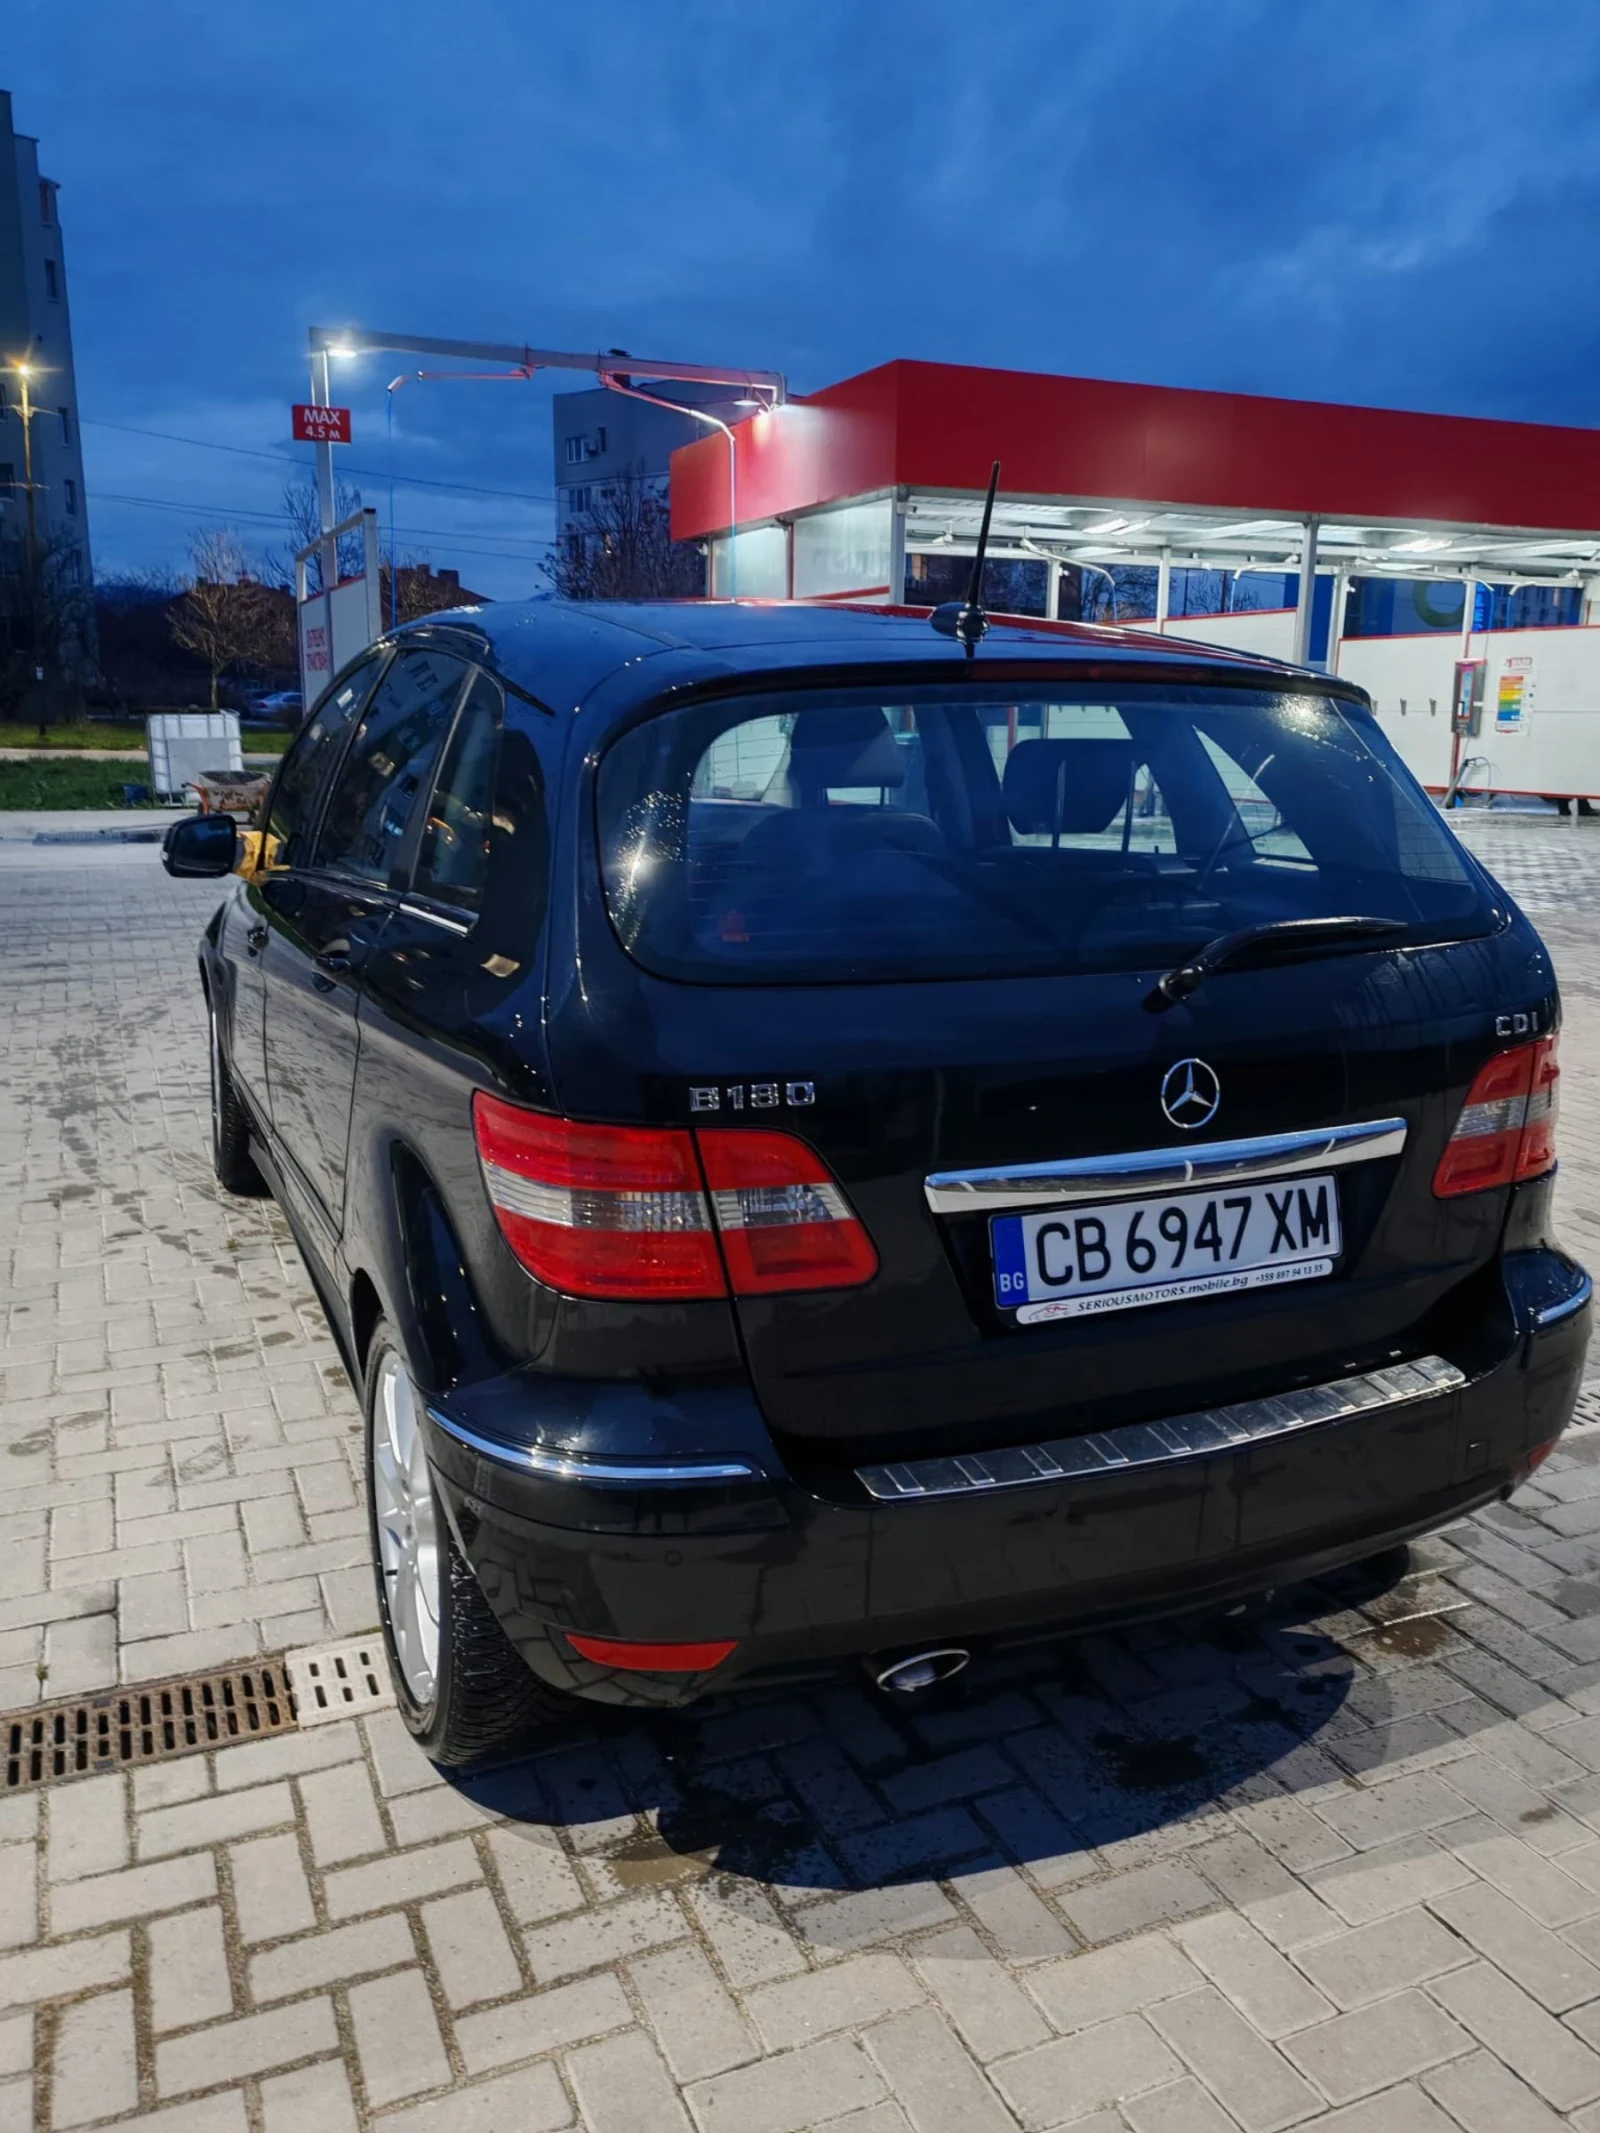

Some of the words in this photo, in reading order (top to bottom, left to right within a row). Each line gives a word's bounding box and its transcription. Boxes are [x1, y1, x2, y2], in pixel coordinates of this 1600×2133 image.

[304, 408, 341, 425] MAX
[305, 425, 325, 439] 4.5
[1495, 1011, 1538, 1036] CDI
[689, 1082, 816, 1112] B180
[1035, 1216, 1112, 1287] CB
[1125, 1196, 1253, 1274] 6947
[1264, 1184, 1332, 1254] XM
[1000, 1272, 1025, 1293] BG
